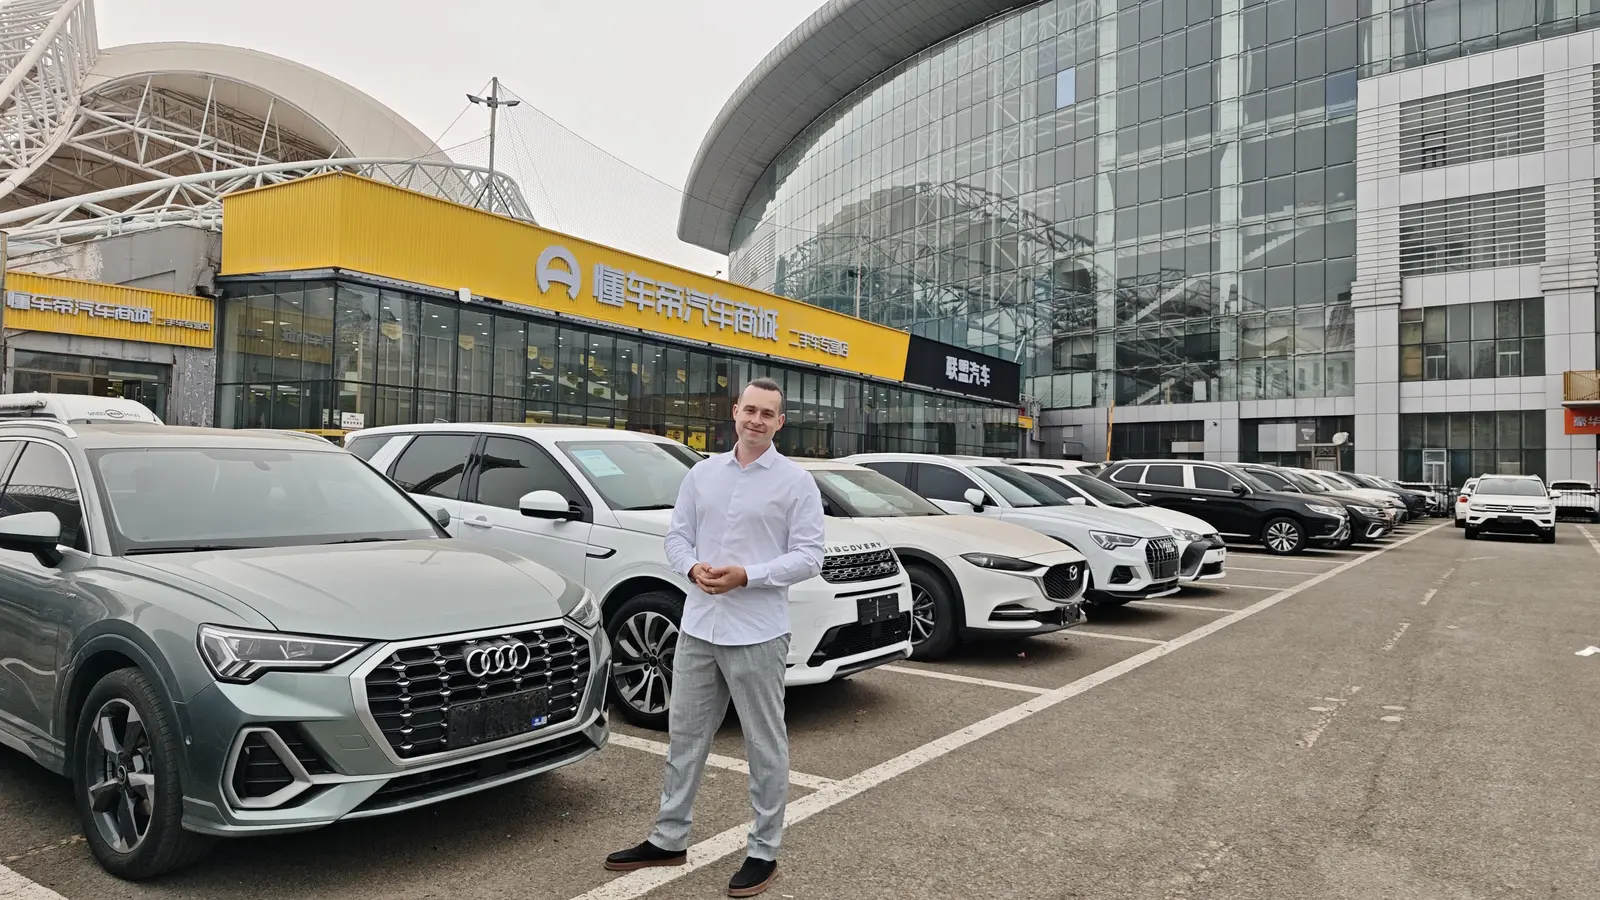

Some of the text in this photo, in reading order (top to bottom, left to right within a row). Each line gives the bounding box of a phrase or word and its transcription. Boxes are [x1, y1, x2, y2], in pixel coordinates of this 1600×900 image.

[7, 291, 153, 323] 懂车帝汽车商城
[593, 263, 779, 341] 懂车帝汽车商城
[945, 355, 991, 387] 联盟汽车
